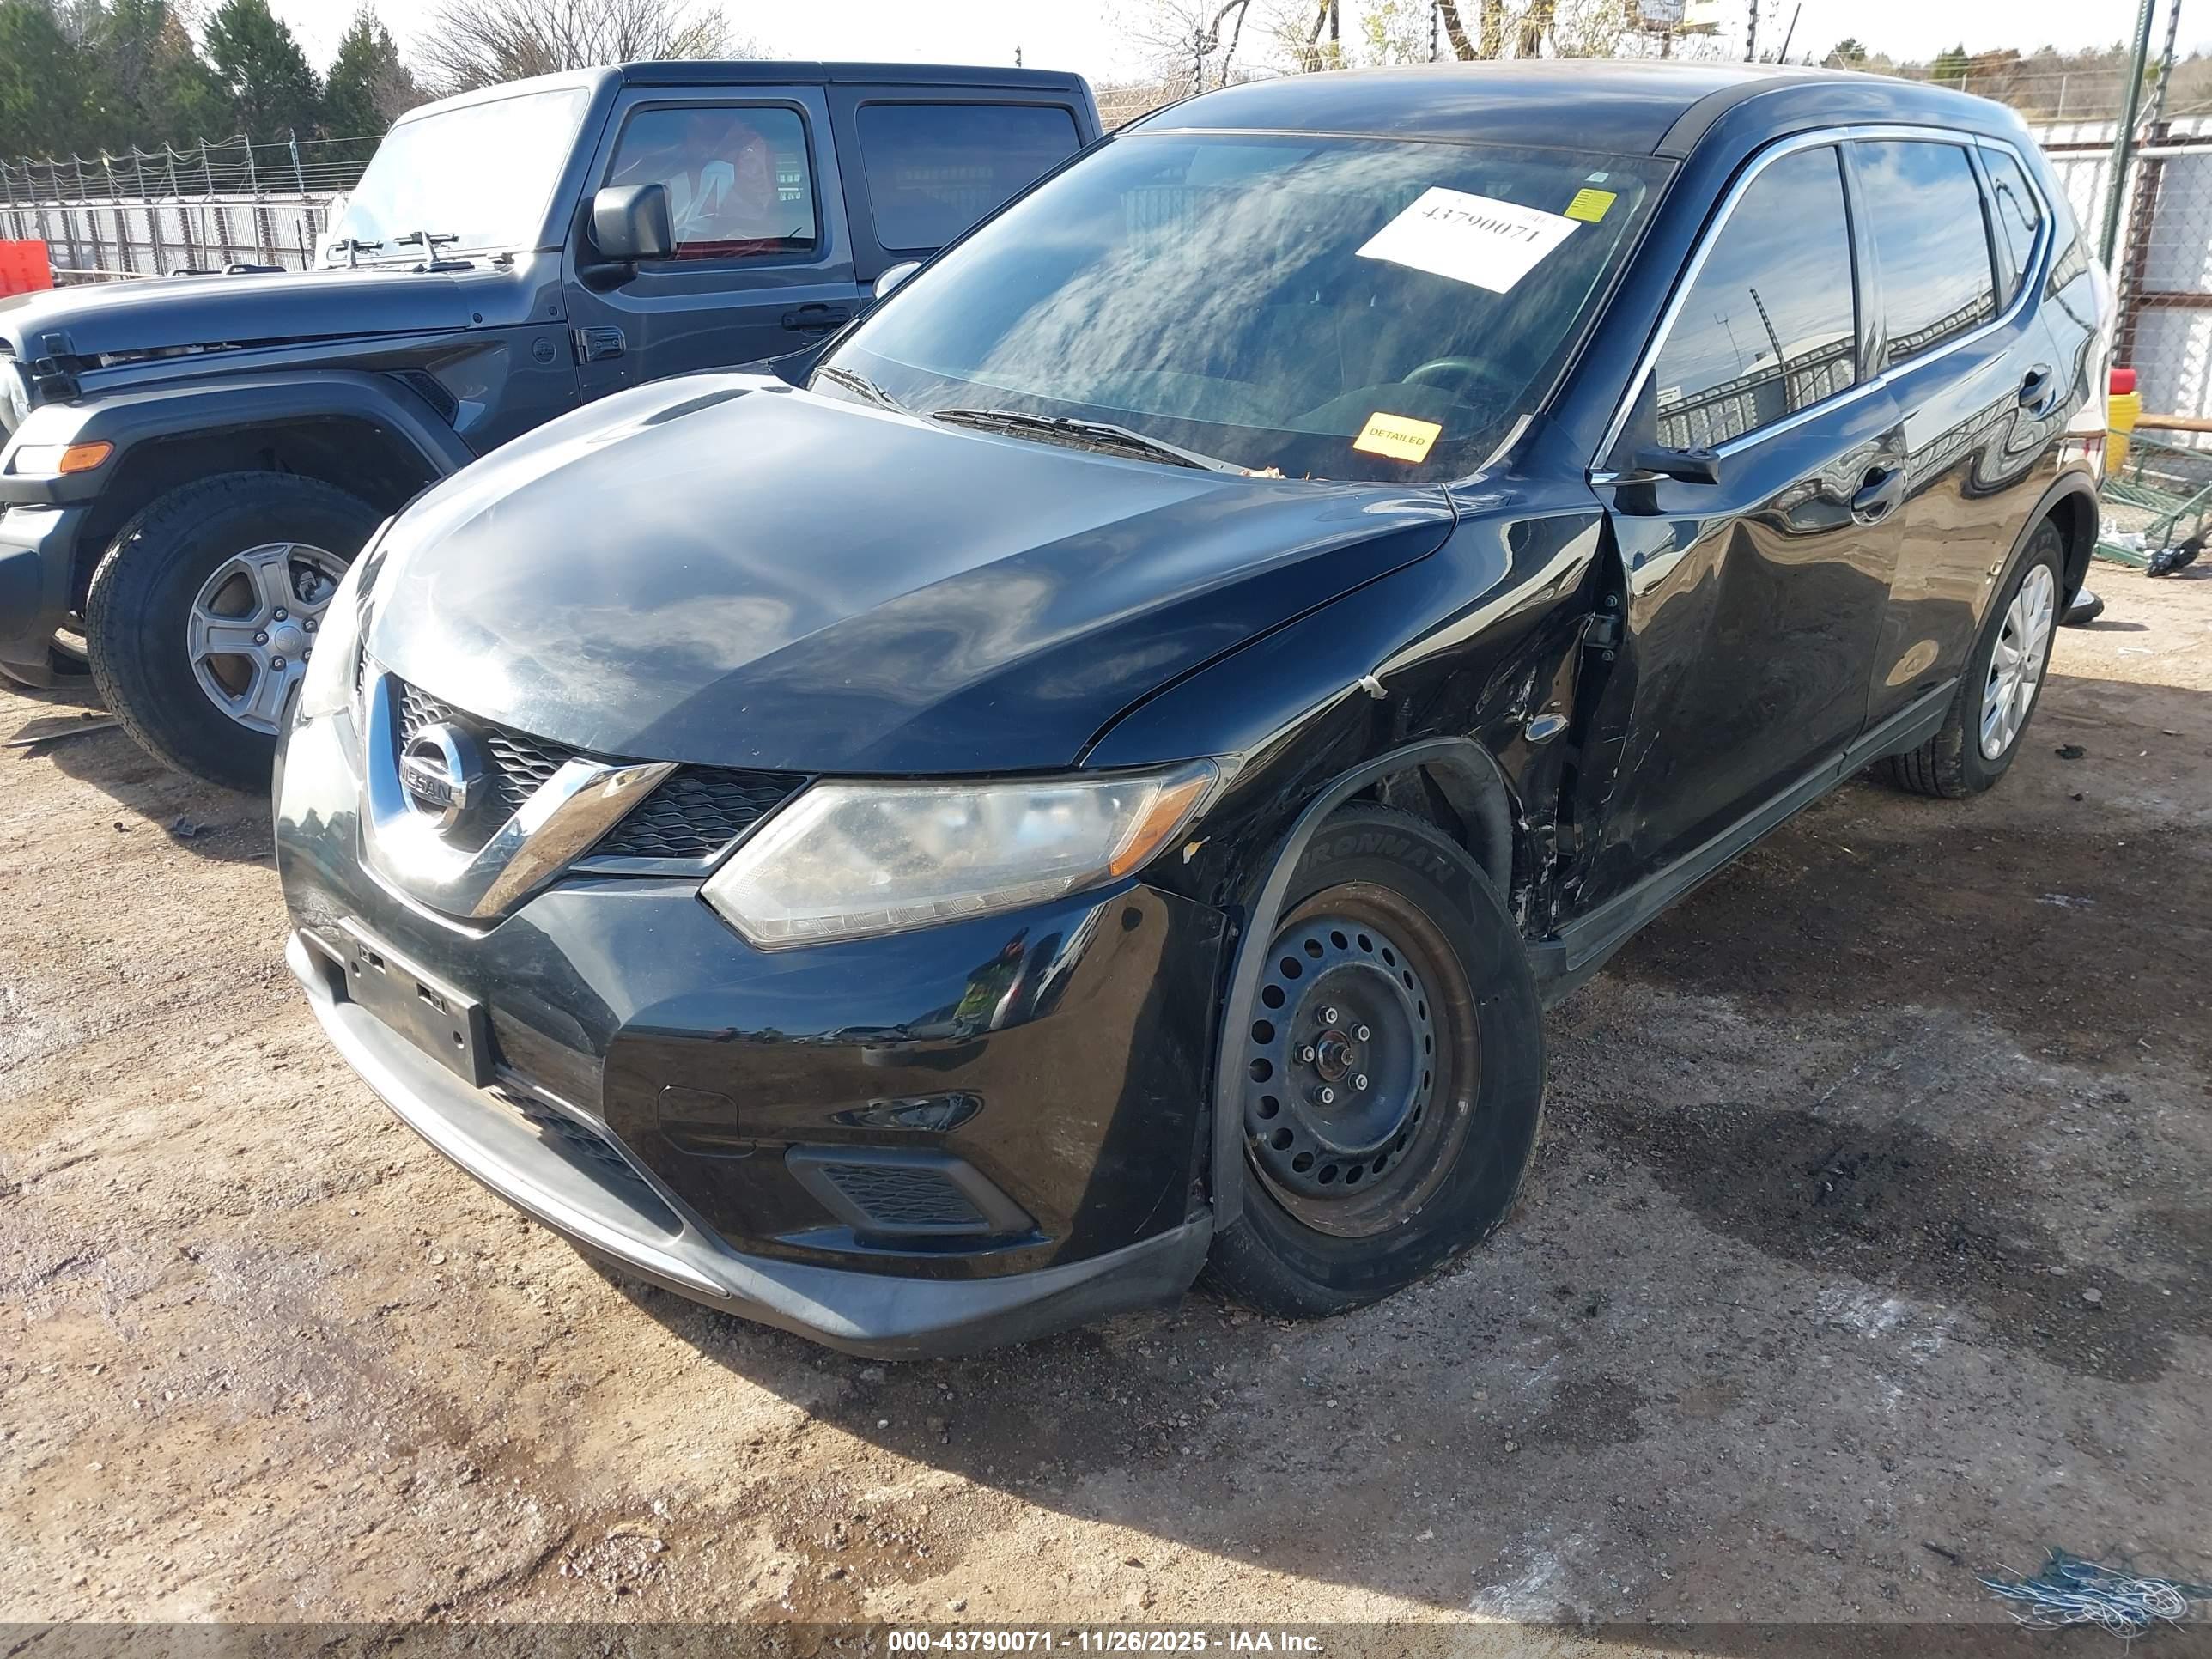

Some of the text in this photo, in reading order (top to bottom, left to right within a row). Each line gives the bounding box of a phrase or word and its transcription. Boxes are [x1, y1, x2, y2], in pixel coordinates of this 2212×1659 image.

[1422, 205, 1540, 243] 43790071
[1369, 428, 1425, 446] DETAILED
[400, 763, 453, 803] NISSAN
[1301, 833, 1456, 883] IRONMAN
